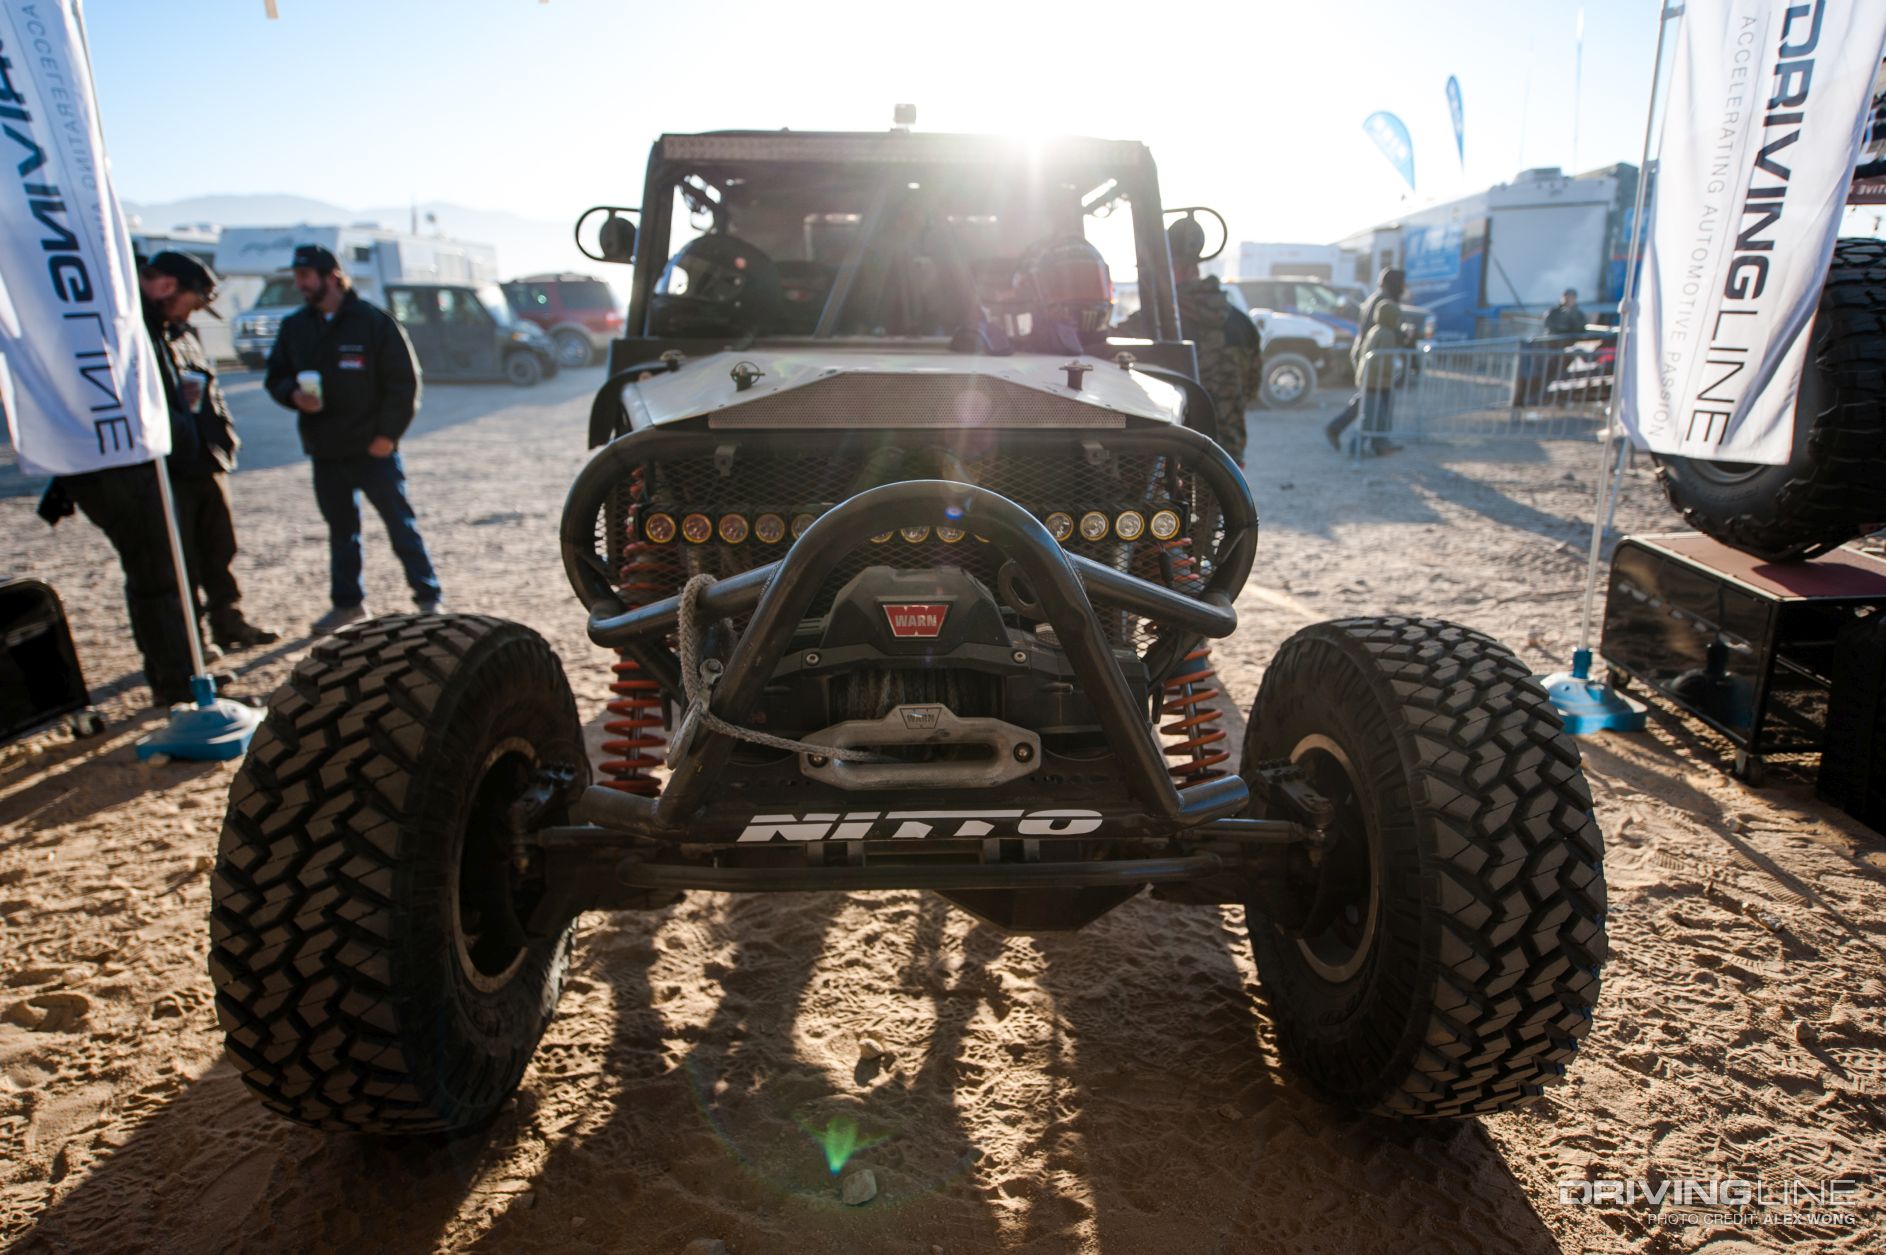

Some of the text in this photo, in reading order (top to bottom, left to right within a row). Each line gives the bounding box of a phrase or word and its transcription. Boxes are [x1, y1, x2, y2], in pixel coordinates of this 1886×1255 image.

[1648, 15, 1757, 437] ACCELERATING AUTOMOTIVE PASSION
[895, 614, 937, 627] WARN
[736, 809, 1103, 842] NITTO
